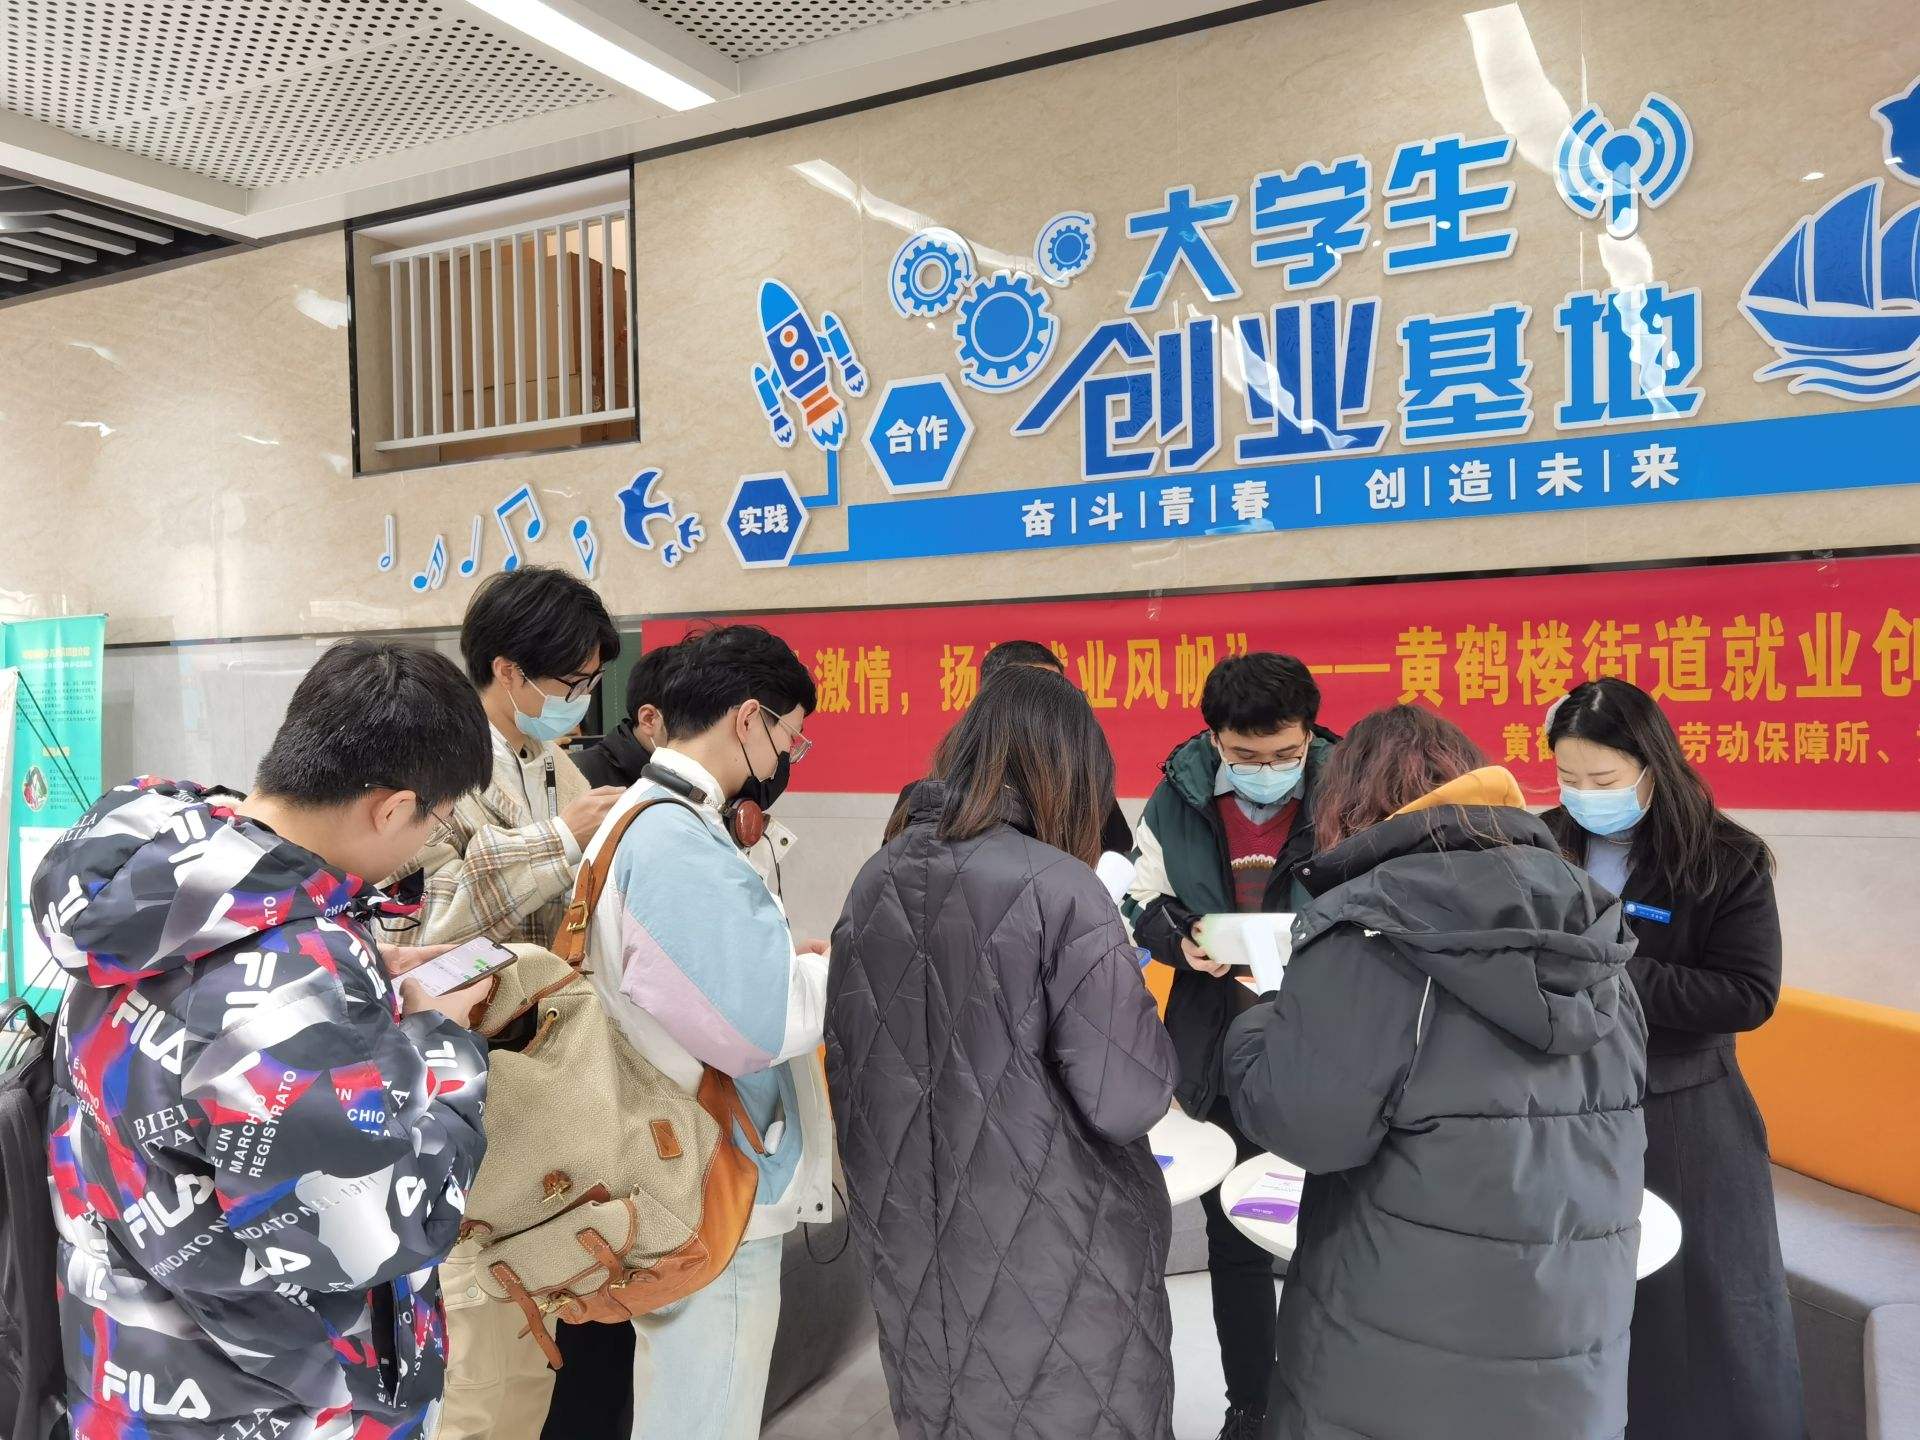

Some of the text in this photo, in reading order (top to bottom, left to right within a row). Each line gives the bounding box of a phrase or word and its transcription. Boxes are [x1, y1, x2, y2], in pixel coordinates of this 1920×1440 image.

[1126, 134, 1516, 313] 大学生
[1012, 282, 1705, 480] 创业基地
[885, 415, 948, 454] 合作
[738, 504, 790, 537] 实践
[112, 989, 186, 1076] FILA
[215, 1128, 234, 1152] UN
[248, 1070, 297, 1178] REGISTRATO
[123, 1173, 216, 1250] FILA
[102, 1360, 212, 1420] FILA
